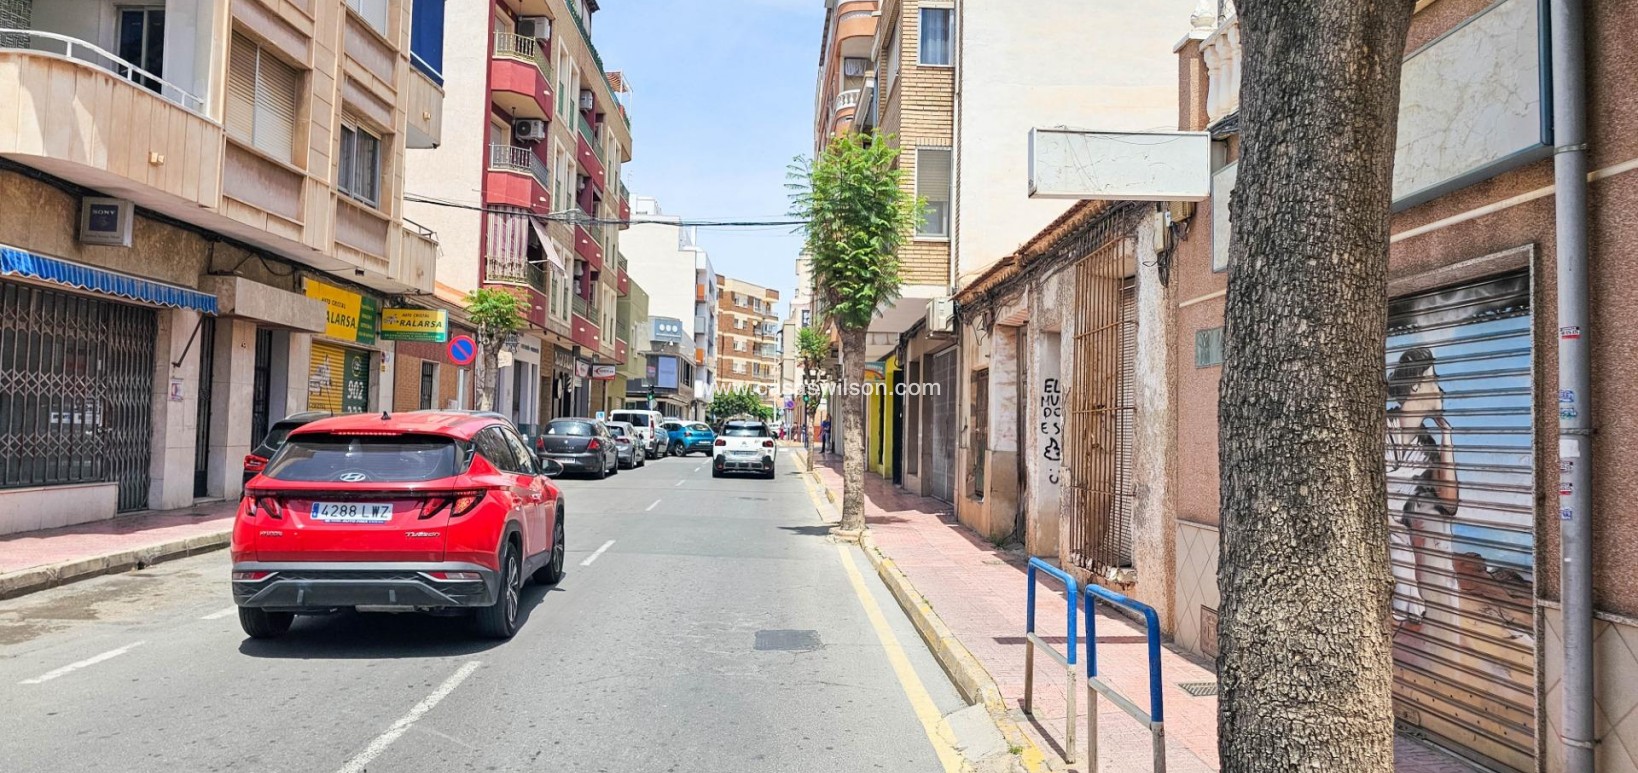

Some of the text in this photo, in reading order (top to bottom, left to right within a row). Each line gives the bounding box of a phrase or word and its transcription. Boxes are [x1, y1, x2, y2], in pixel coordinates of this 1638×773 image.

[399, 319, 442, 328] RALARSA
[347, 380, 364, 400] 902
[1044, 378, 1060, 394] EL
[321, 504, 390, 518] 4288 LWZ
